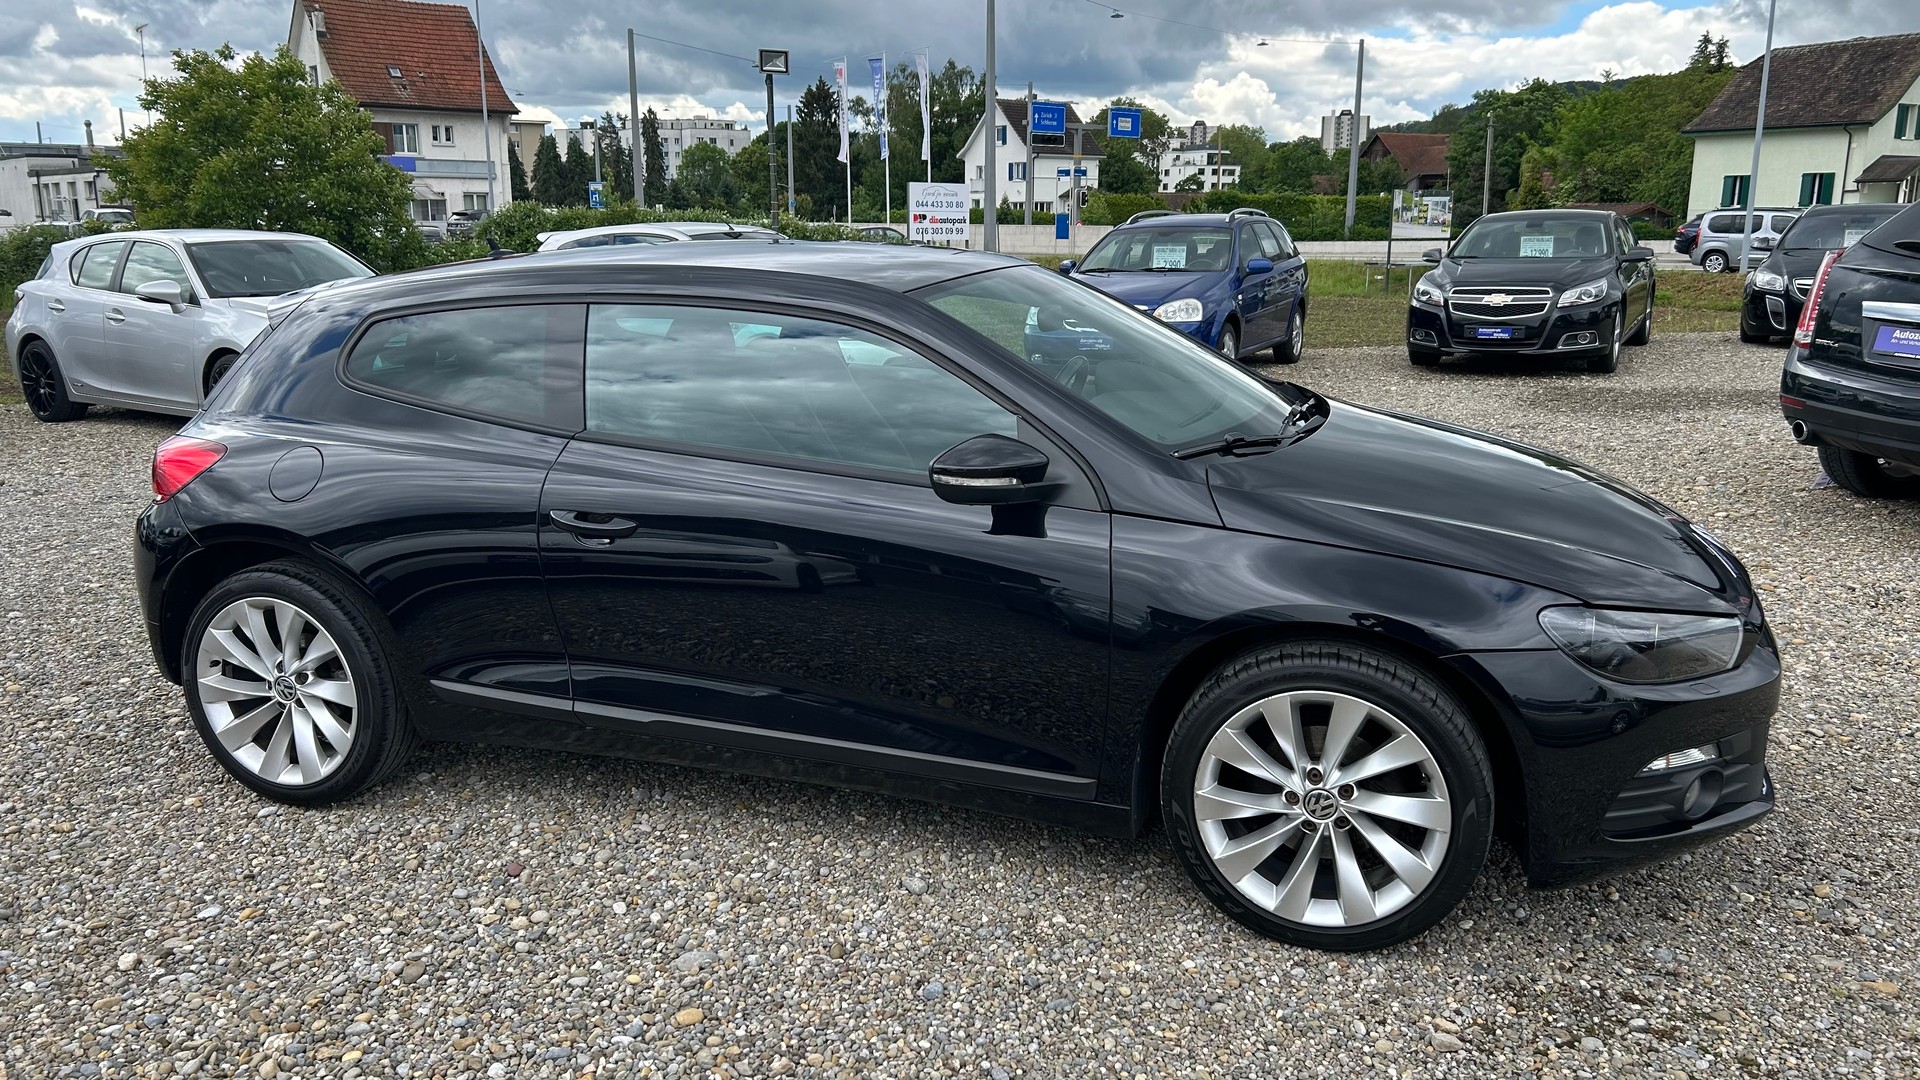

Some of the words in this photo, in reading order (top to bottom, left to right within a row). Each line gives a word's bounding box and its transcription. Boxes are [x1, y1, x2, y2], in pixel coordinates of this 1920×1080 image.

[945, 201, 954, 209] 30
[955, 201, 964, 209] 80
[929, 216, 966, 226] dinautopark
[915, 227, 929, 235] 076
[930, 227, 944, 235] 303
[945, 227, 954, 235] 09
[955, 227, 964, 235] 99
